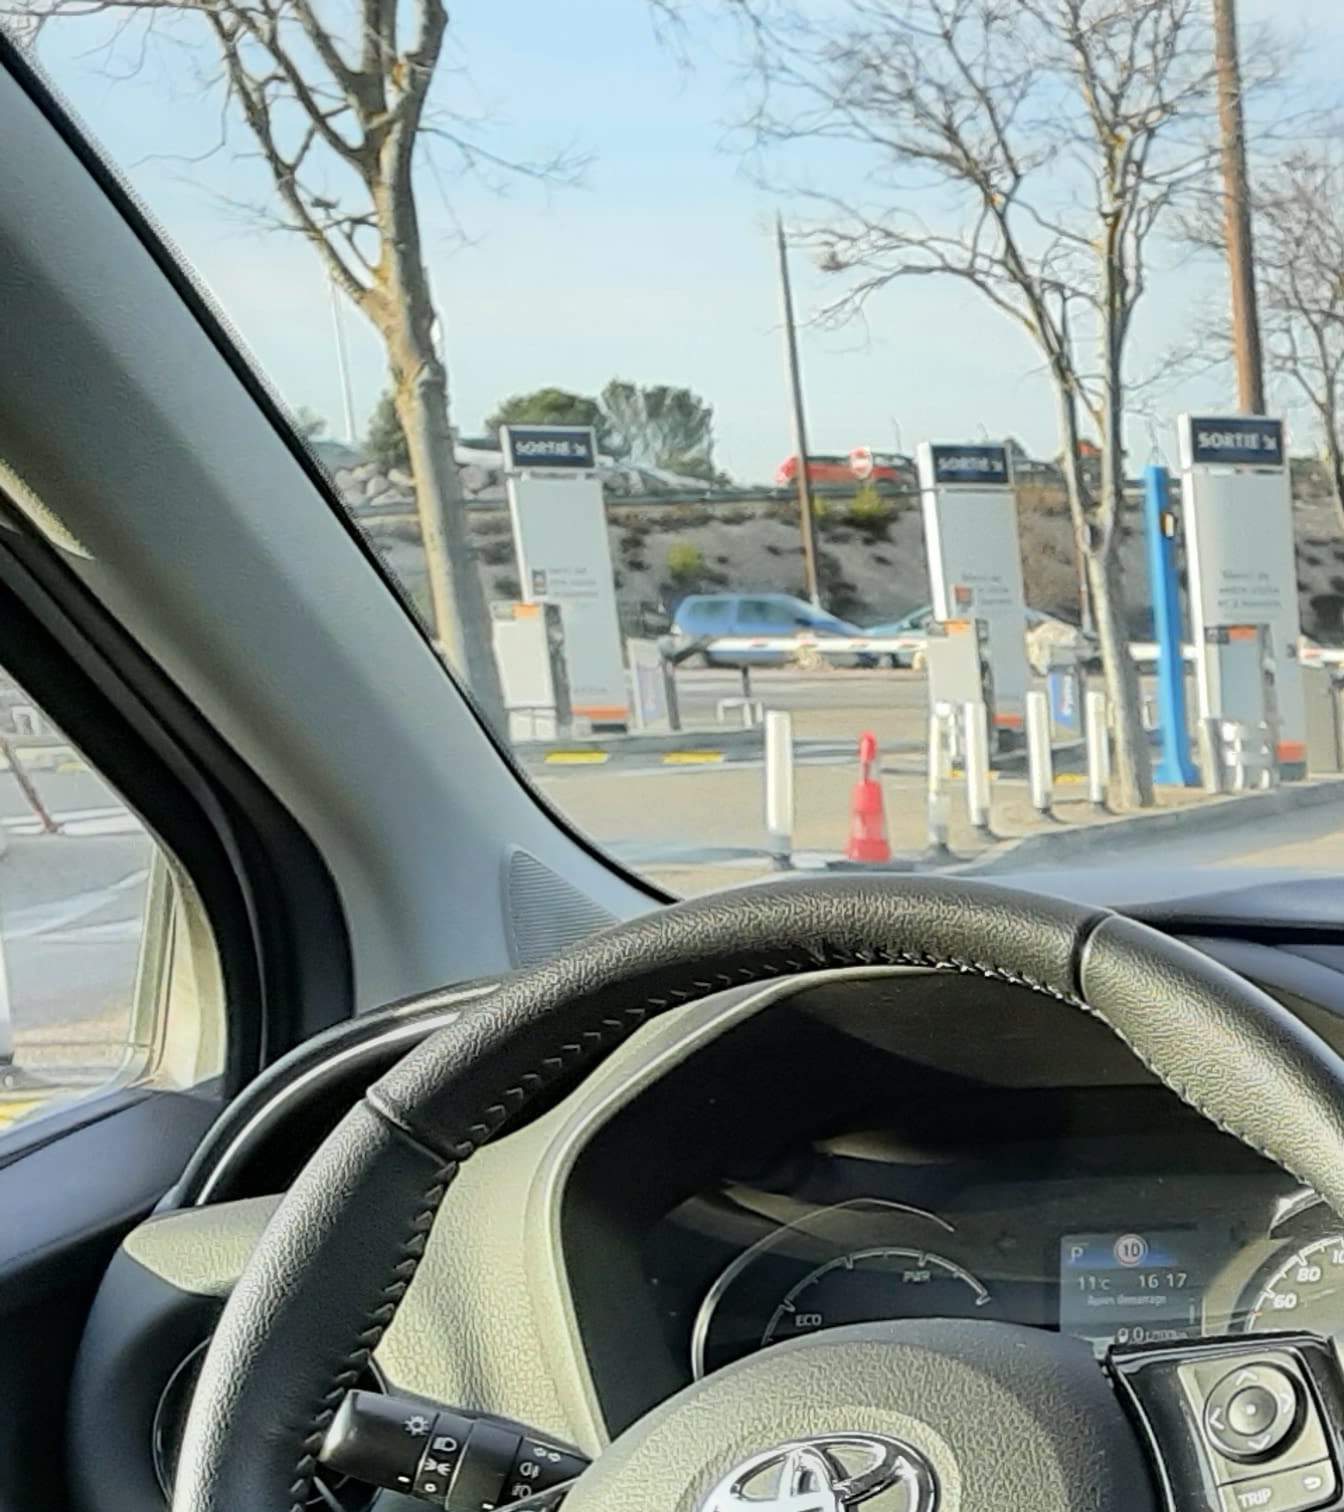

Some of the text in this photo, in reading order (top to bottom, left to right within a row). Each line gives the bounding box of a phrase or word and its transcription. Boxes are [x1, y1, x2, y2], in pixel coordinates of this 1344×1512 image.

[1198, 431, 1259, 449] SORTIE
[1123, 1243, 1144, 1258] 10
[903, 1270, 930, 1283] PWR
[1296, 1267, 1321, 1282] 80
[1273, 1293, 1298, 1308] 60
[795, 1314, 822, 1327] ECO
[1238, 1487, 1272, 1508] TRIP
